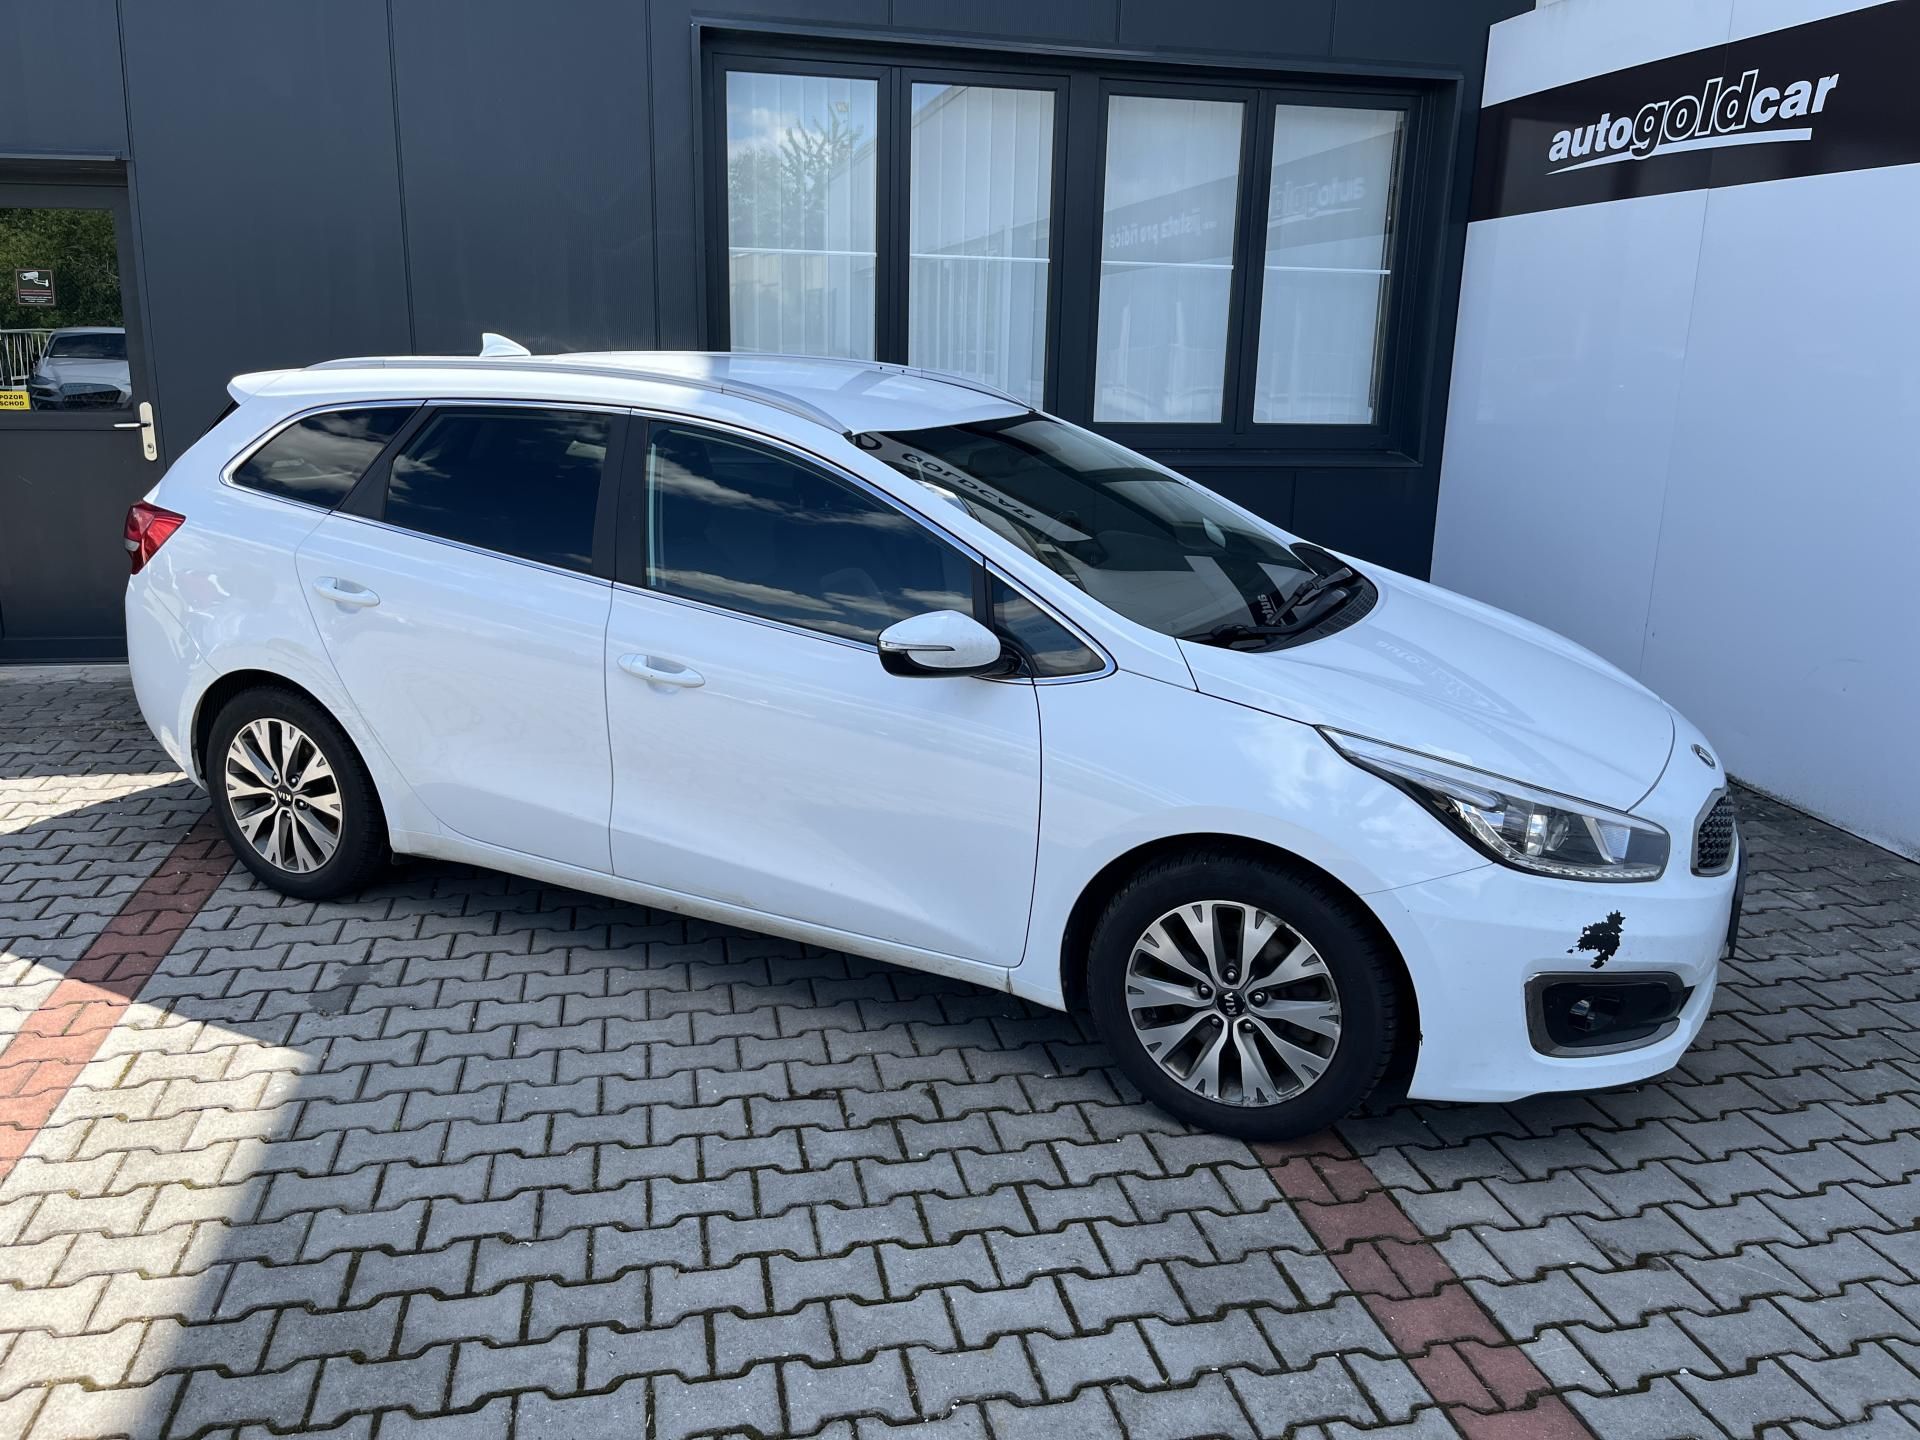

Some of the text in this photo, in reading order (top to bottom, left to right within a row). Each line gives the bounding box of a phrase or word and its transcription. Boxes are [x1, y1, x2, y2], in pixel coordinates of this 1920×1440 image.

[1548, 69, 1840, 160] autogoldcar
[278, 791, 291, 801] KIA
[1224, 991, 1237, 1015] KIA
